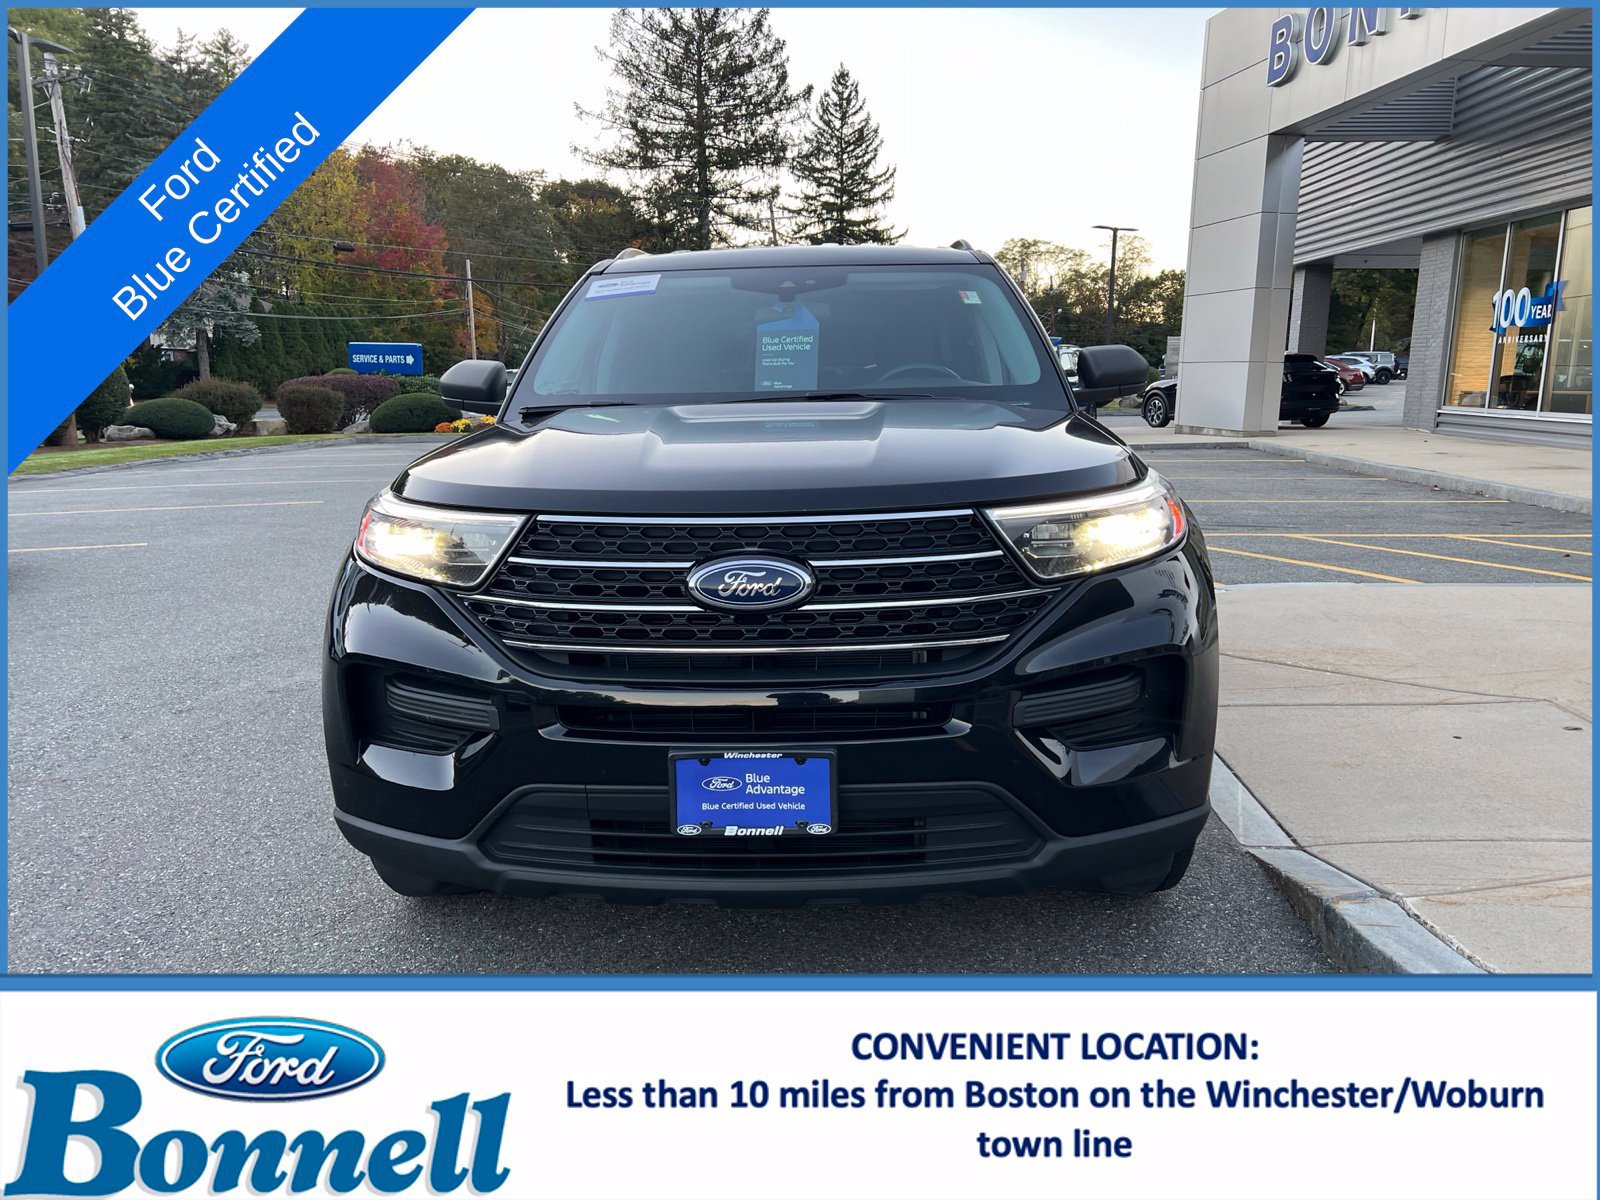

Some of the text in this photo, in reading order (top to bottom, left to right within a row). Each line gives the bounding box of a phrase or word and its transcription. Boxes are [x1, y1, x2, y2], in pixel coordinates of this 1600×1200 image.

[1267, 8, 1422, 86] BON
[1493, 287, 1531, 328] 100
[762, 335, 814, 344] Blue Certified
[1498, 334, 1549, 344] ANNIVERSARY
[352, 354, 405, 364] SERVICE & PARTS
[718, 570, 782, 597] Ford
[709, 778, 735, 789] Ford
[745, 773, 771, 783] Blue
[745, 784, 805, 796] Advantage
[702, 802, 805, 810] Blue Certified Used Vehicle
[724, 825, 784, 836] Bonnell
